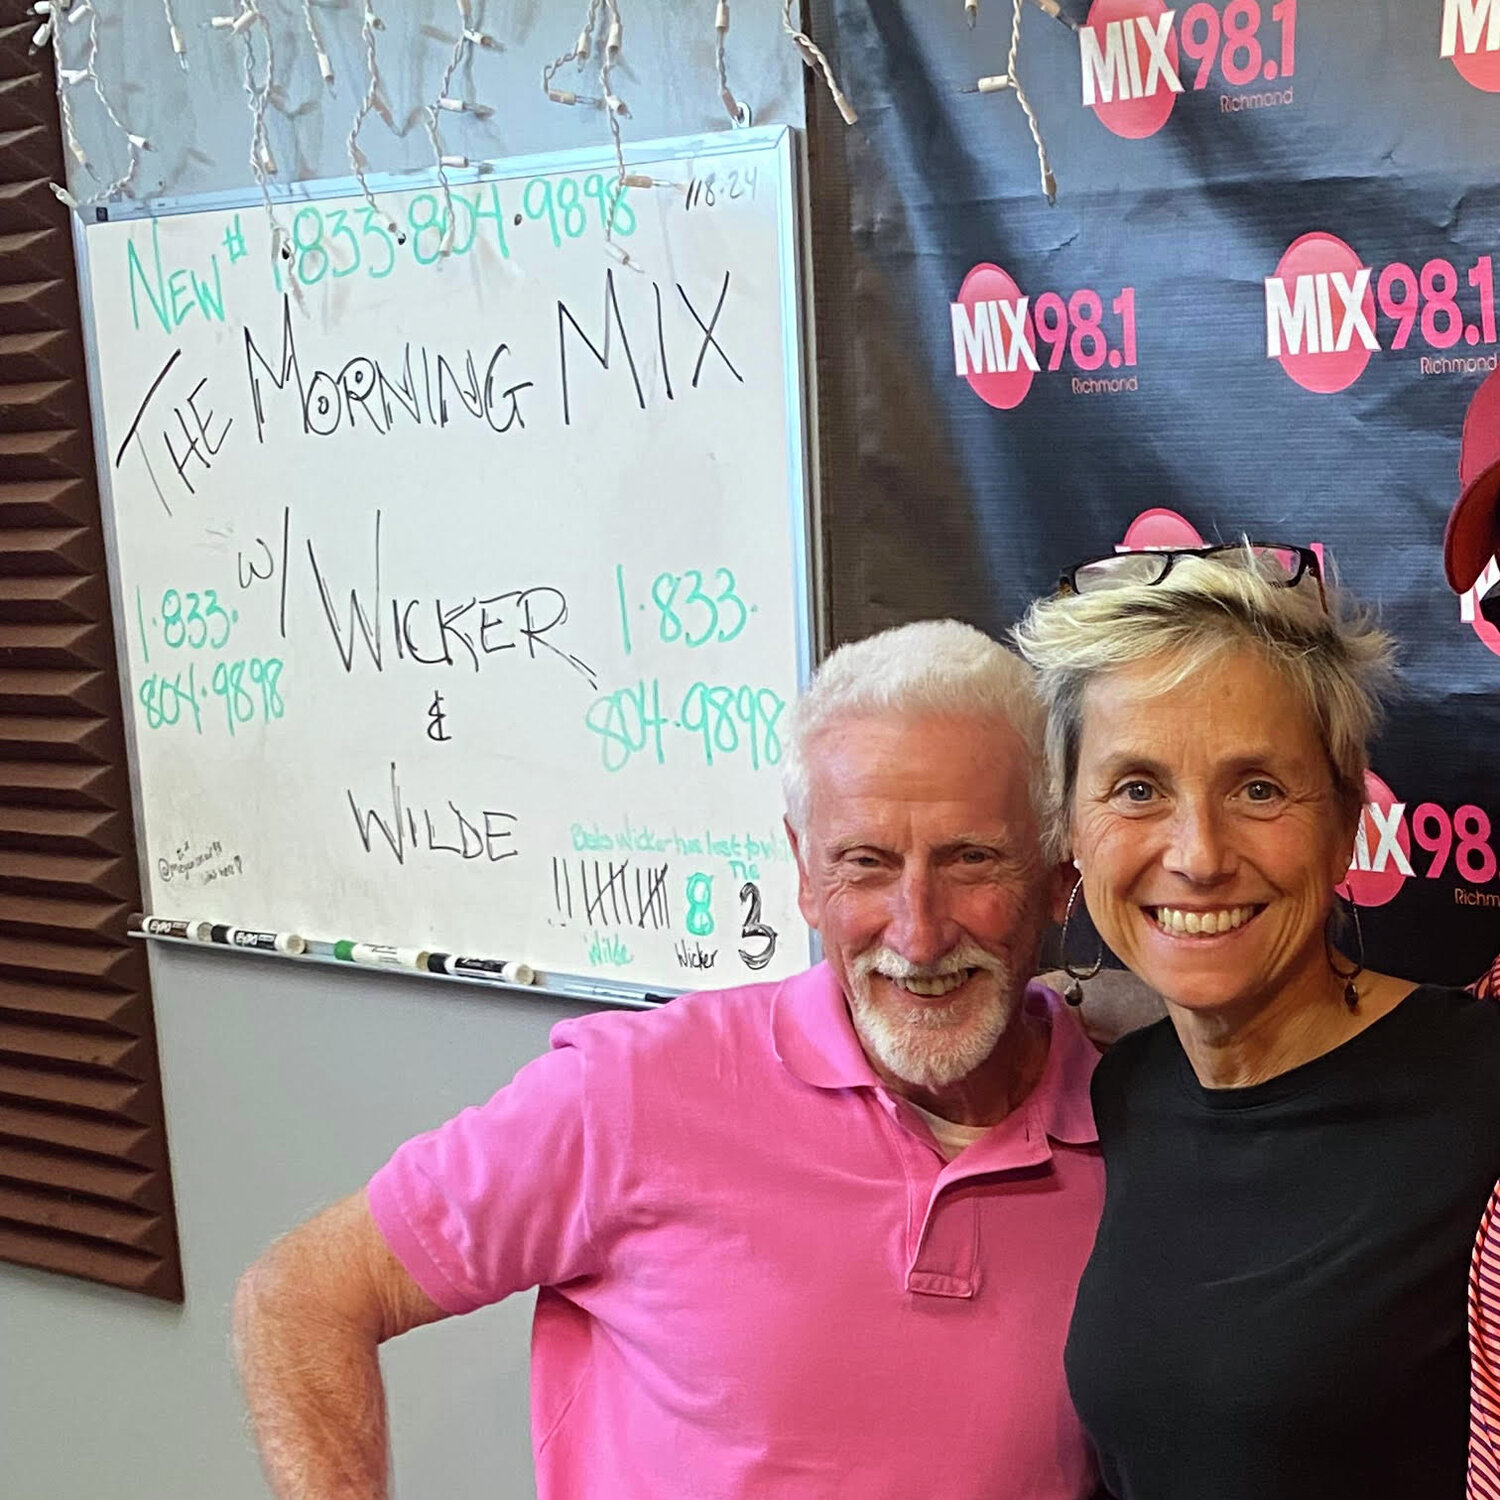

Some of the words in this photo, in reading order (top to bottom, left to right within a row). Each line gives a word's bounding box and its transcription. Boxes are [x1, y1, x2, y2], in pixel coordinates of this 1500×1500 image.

[1078, 10, 1184, 107] MIX
[1181, 0, 1297, 91] 98.1
[1220, 86, 1293, 114] Richmond
[222, 213, 248, 265] #
[950, 297, 1040, 377] MIX
[1034, 286, 1138, 372] 98.1
[1264, 267, 1382, 360] MIX
[1377, 255, 1498, 351] 98.1
[116, 349, 234, 517] THE
[243, 294, 534, 444] MORNING
[556, 268, 745, 426] MIX
[1072, 374, 1138, 395] Richmond
[1420, 352, 1497, 376] Richmond
[348, 762, 519, 864] WILDE
[1348, 802, 1417, 878] IX
[686, 872, 715, 937] 8
